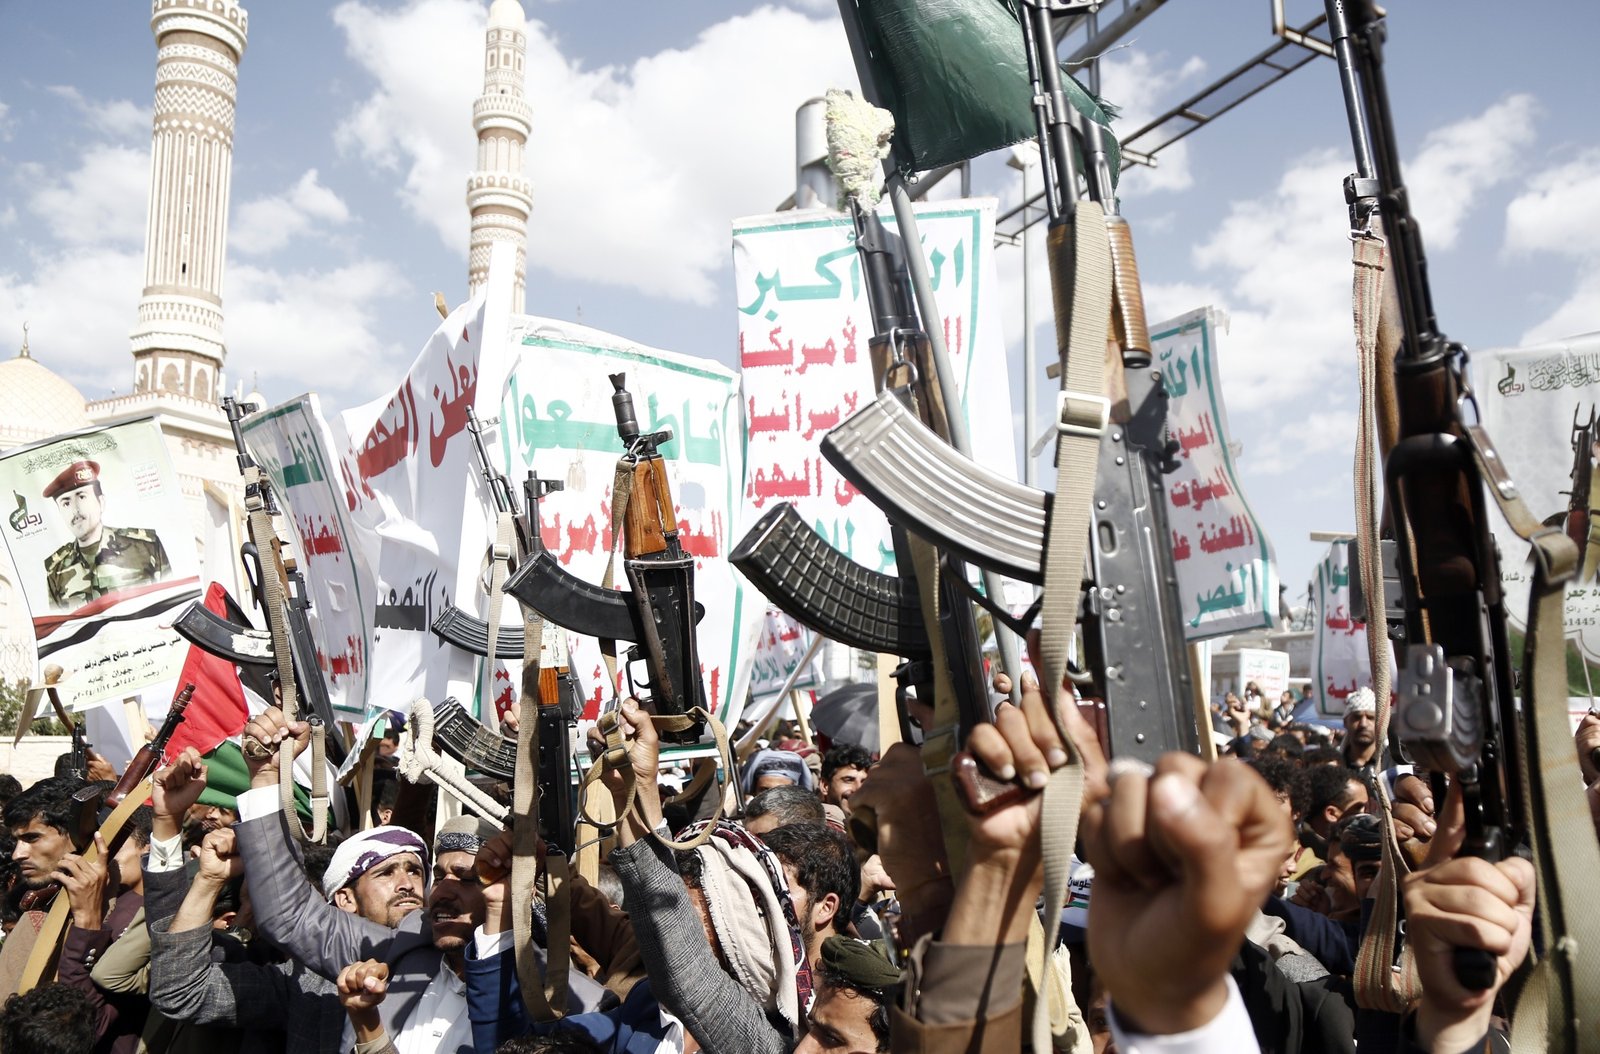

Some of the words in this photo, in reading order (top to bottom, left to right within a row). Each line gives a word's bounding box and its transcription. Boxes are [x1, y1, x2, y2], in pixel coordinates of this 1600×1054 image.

[738, 231, 859, 322] أكبر
[1170, 464, 1234, 511] الموت
[1171, 528, 1192, 561] عل
[1200, 513, 1254, 554] اللعنة
[1190, 560, 1258, 628] النصر
